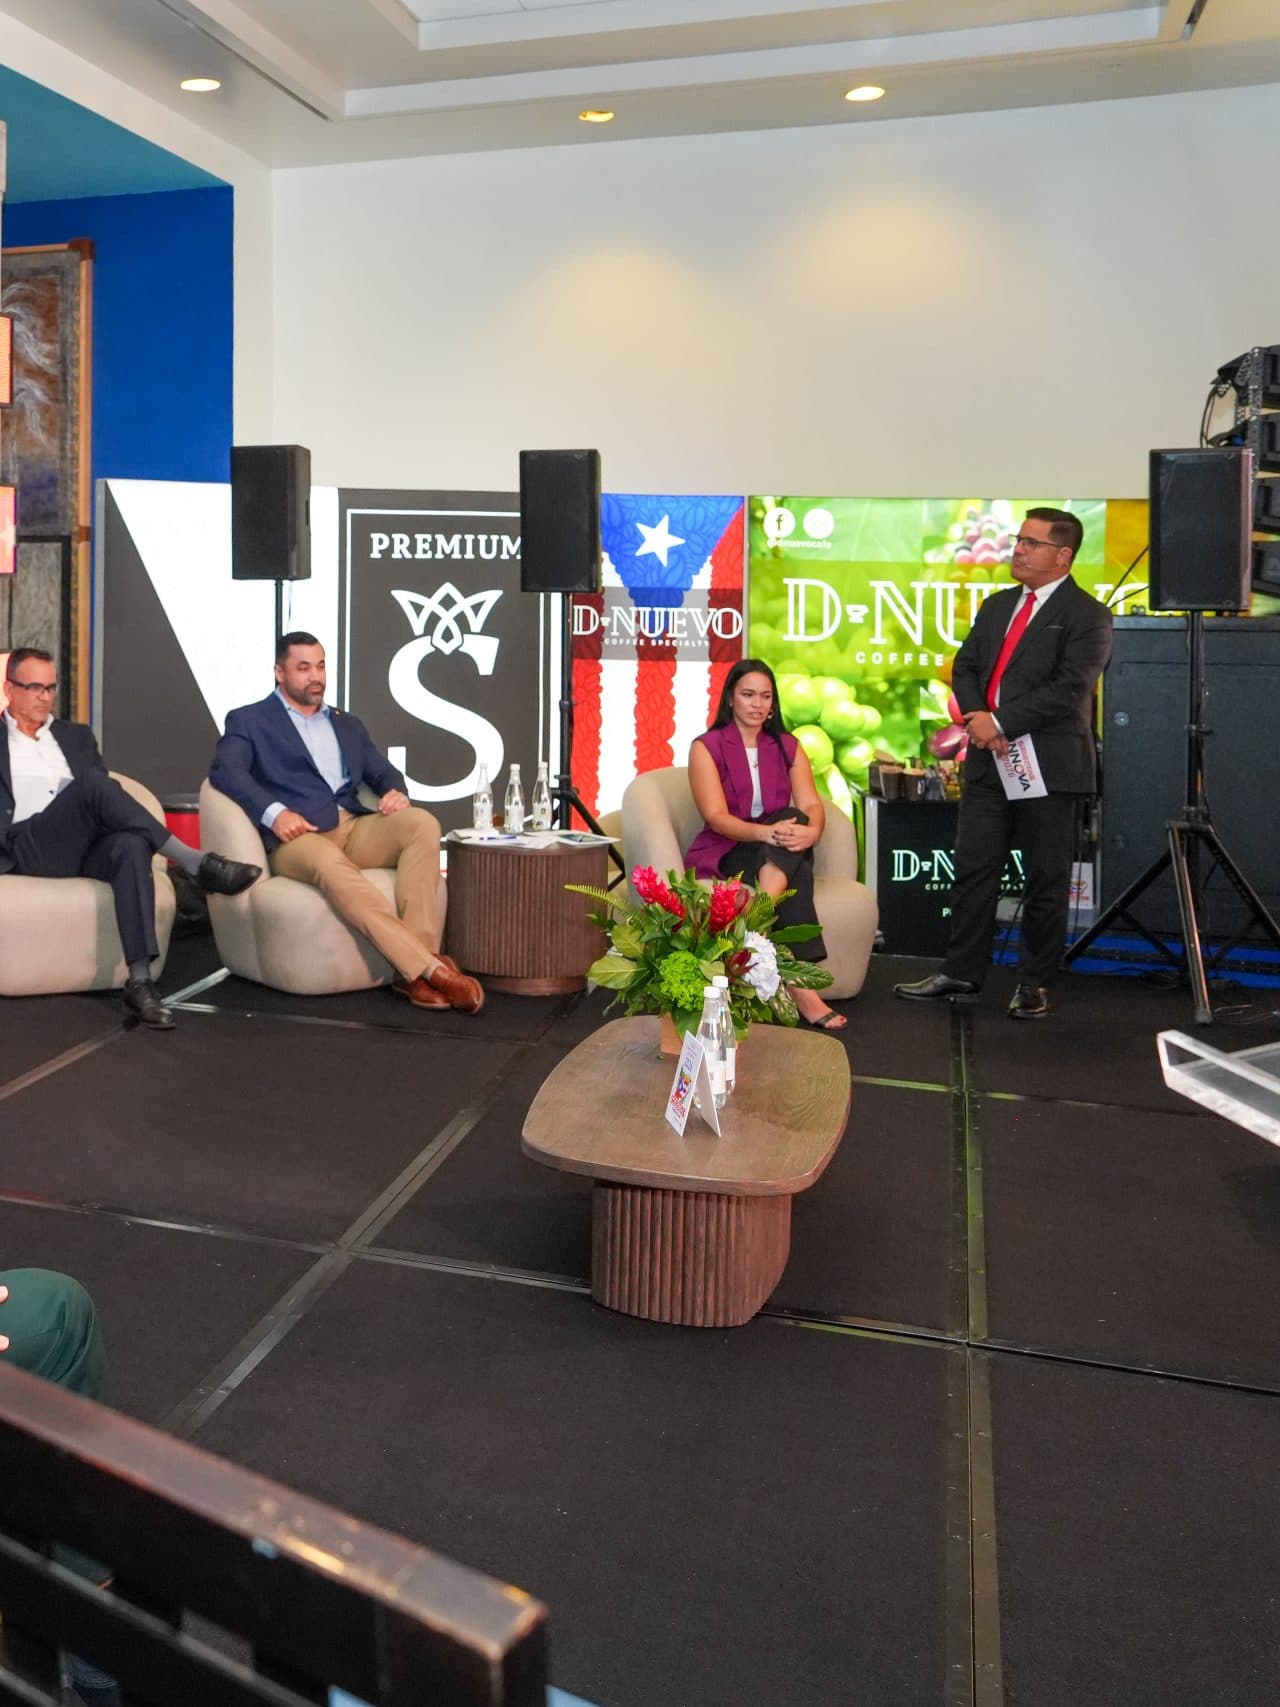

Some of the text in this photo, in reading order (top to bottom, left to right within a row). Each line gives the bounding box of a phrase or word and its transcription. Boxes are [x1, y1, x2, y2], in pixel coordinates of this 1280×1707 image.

[370, 533, 521, 559] PREMIUM
[573, 605, 743, 639] D-NUEVO
[604, 638, 710, 647] COFFEE SPECIALTY
[855, 652, 944, 666] COFFEE
[388, 633, 504, 802] S
